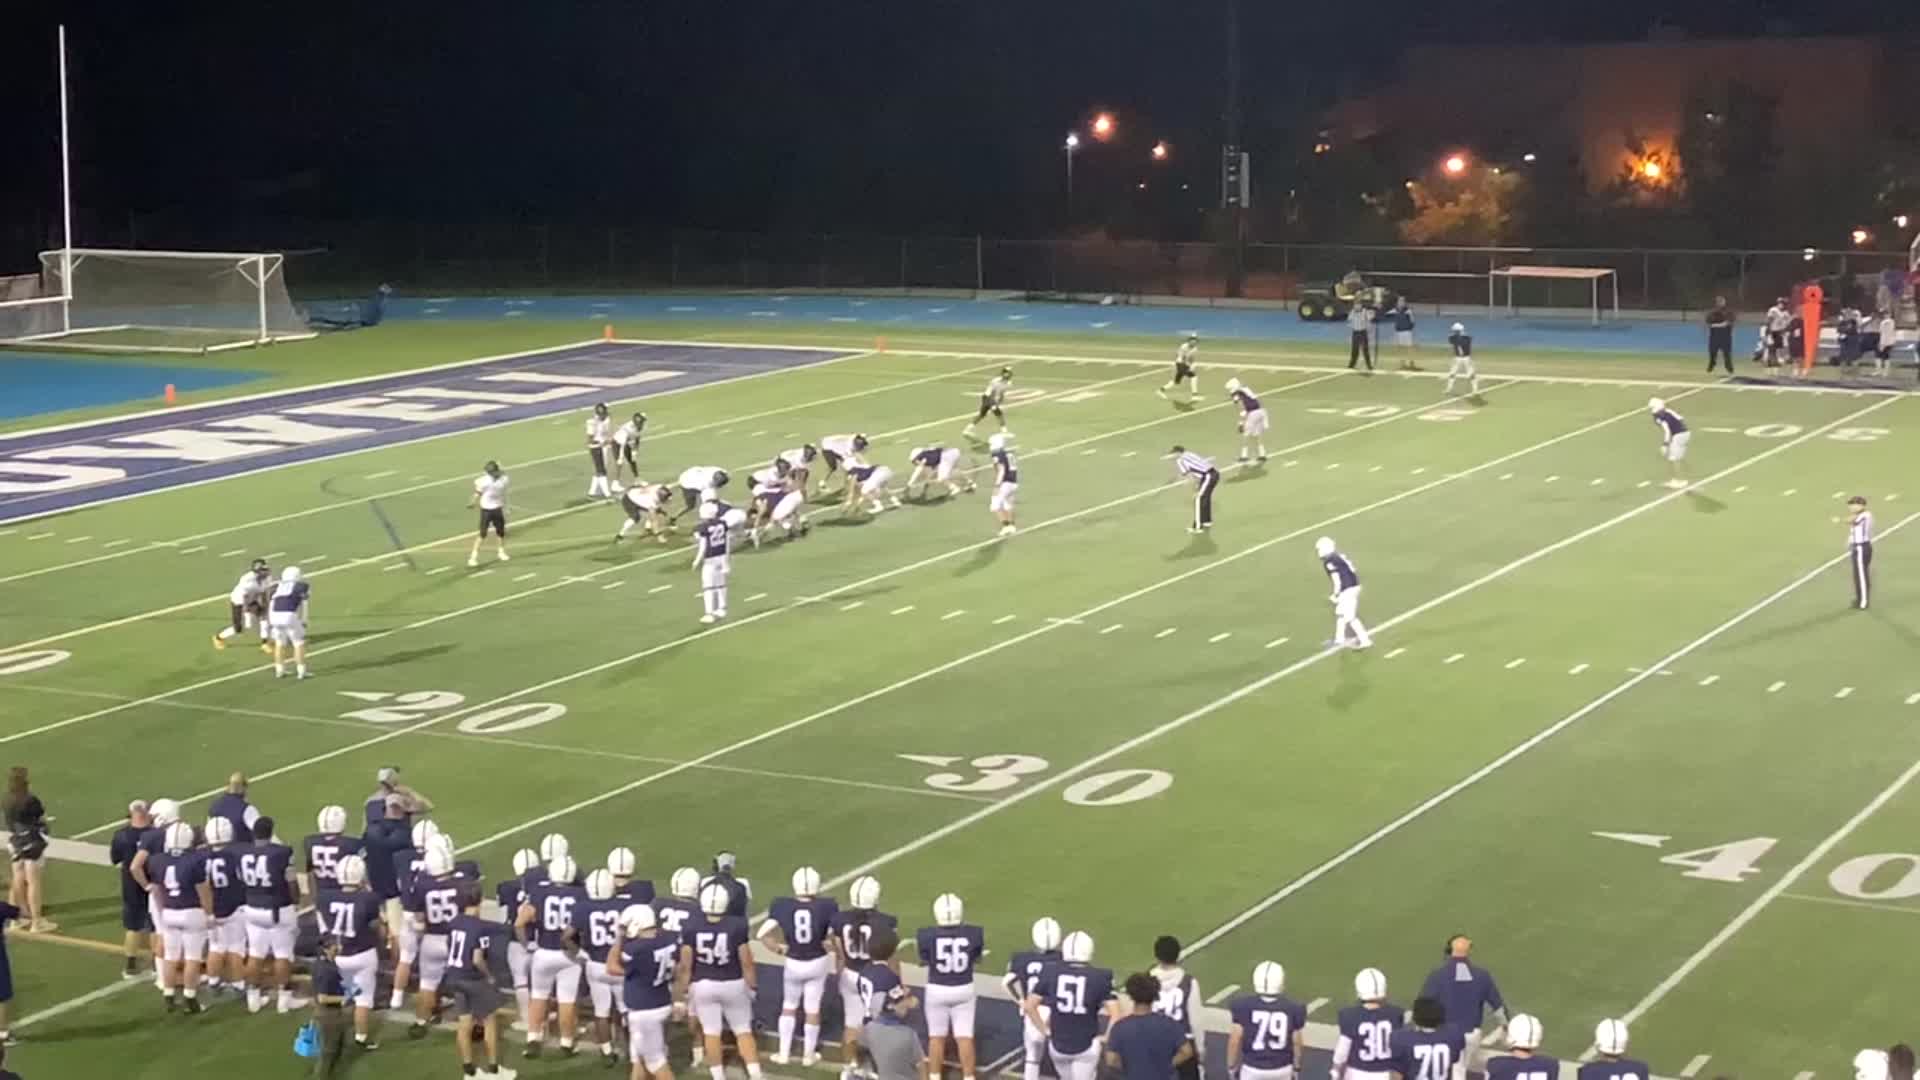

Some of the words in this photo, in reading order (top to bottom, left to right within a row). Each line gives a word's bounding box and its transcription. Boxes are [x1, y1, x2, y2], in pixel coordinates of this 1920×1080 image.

[241, 854, 273, 888] 64
[311, 845, 340, 879] 55
[164, 865, 182, 897] 4
[329, 901, 356, 938] 71
[425, 888, 458, 925] 65
[589, 909, 620, 947] 63
[793, 908, 812, 944] 8
[695, 932, 731, 966] 54
[936, 936, 970, 974] 56
[1056, 974, 1088, 1015] 51
[1251, 1009, 1289, 1051] 79
[1357, 1019, 1393, 1062] 30
[1412, 1043, 1450, 1080] 70
